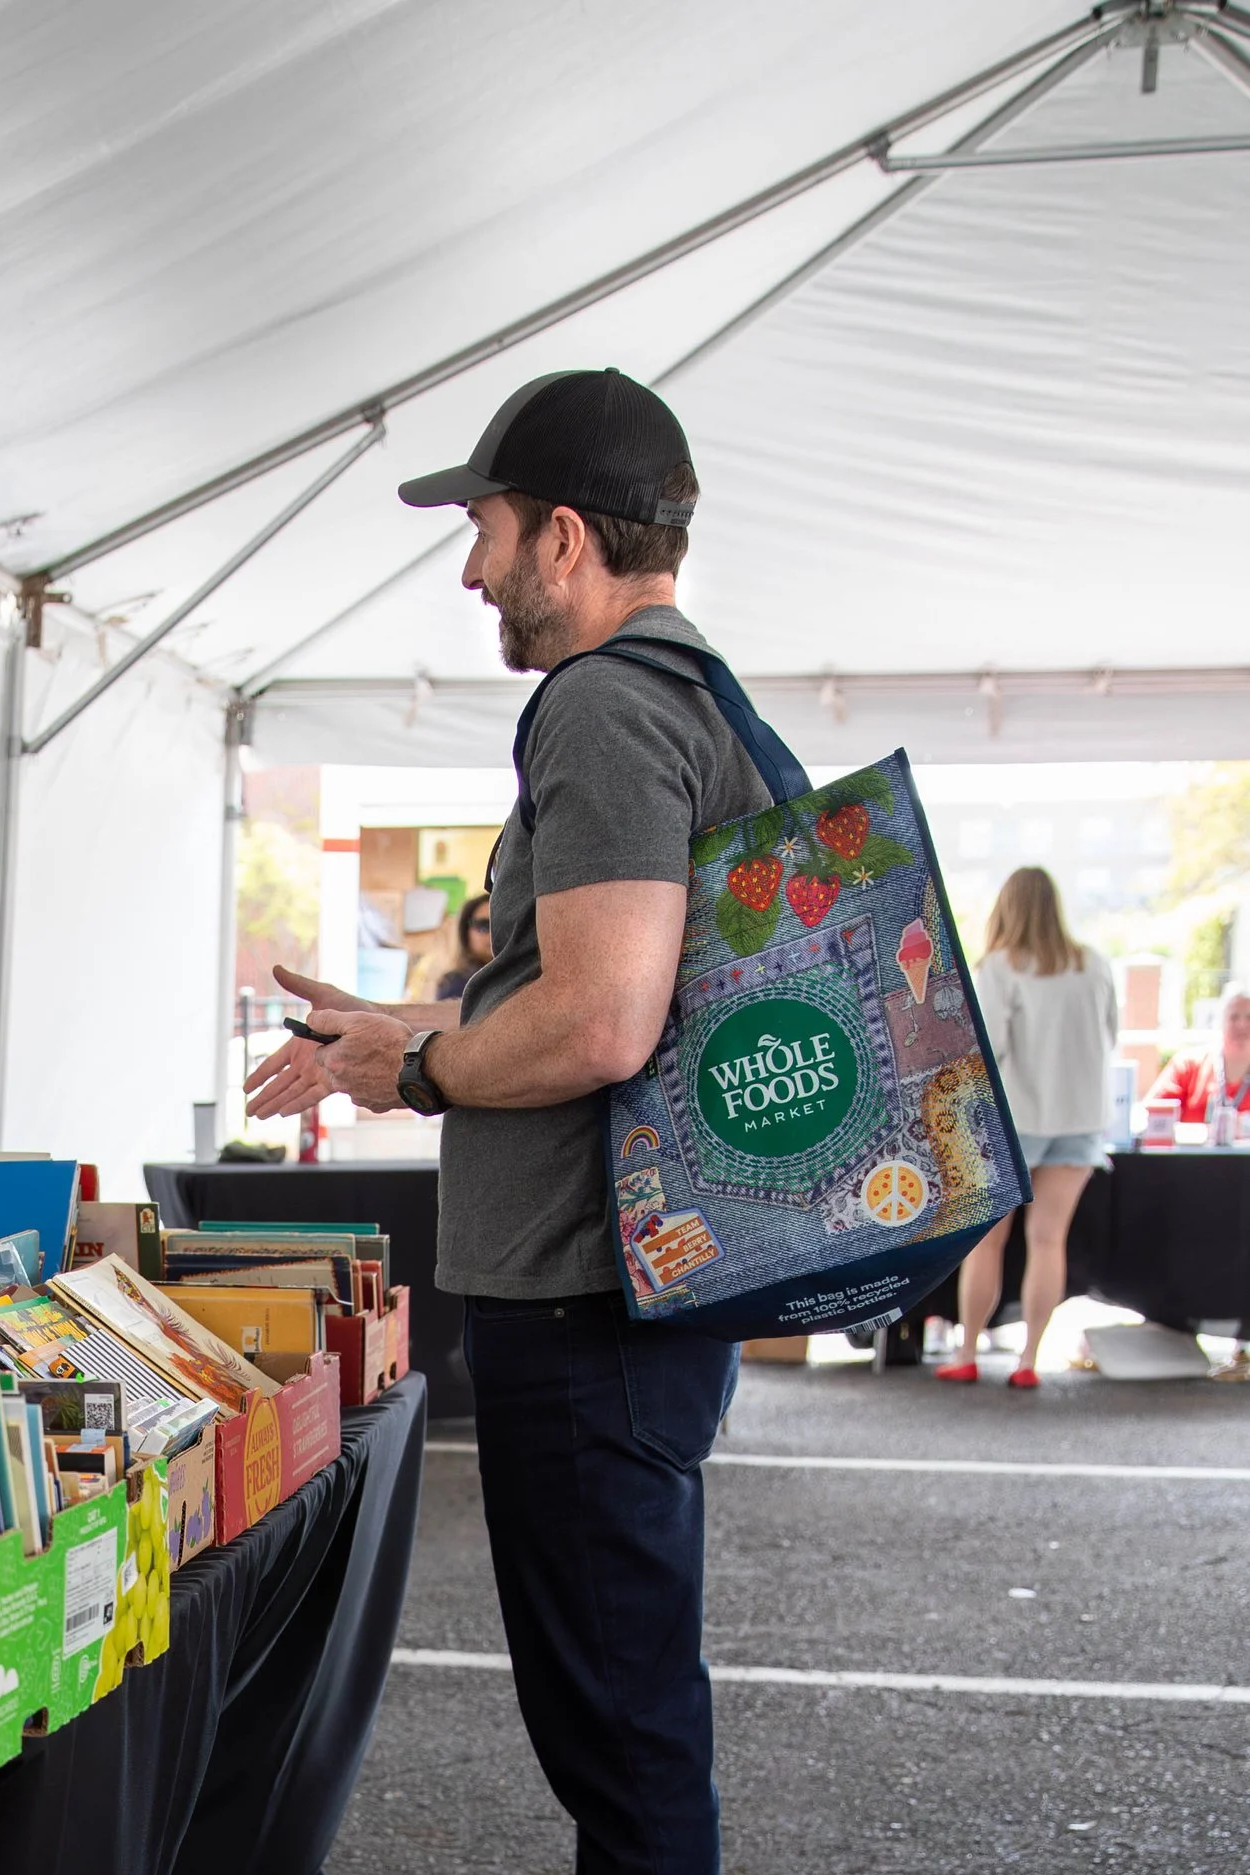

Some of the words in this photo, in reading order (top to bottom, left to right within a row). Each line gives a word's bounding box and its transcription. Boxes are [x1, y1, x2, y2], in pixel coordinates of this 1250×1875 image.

[708, 1033, 836, 1090] WHOLE
[722, 1062, 839, 1119] FOODS
[744, 1099, 826, 1133] MARKET
[676, 1219, 701, 1236] TEAM
[682, 1233, 708, 1253] BERRY
[671, 1248, 716, 1277] CHANTILLY
[778, 1311, 811, 1322] from
[814, 1299, 851, 1313] 100%
[853, 1277, 910, 1302] recycled
[786, 1296, 816, 1311] This
[818, 1290, 845, 1303] bag
[847, 1286, 858, 1295] is
[860, 1275, 899, 1291] made
[801, 1307, 845, 1324] plastic
[847, 1292, 897, 1310] bottles.
[251, 1421, 279, 1453] ALWAYS
[246, 1444, 281, 1500] FRESH
